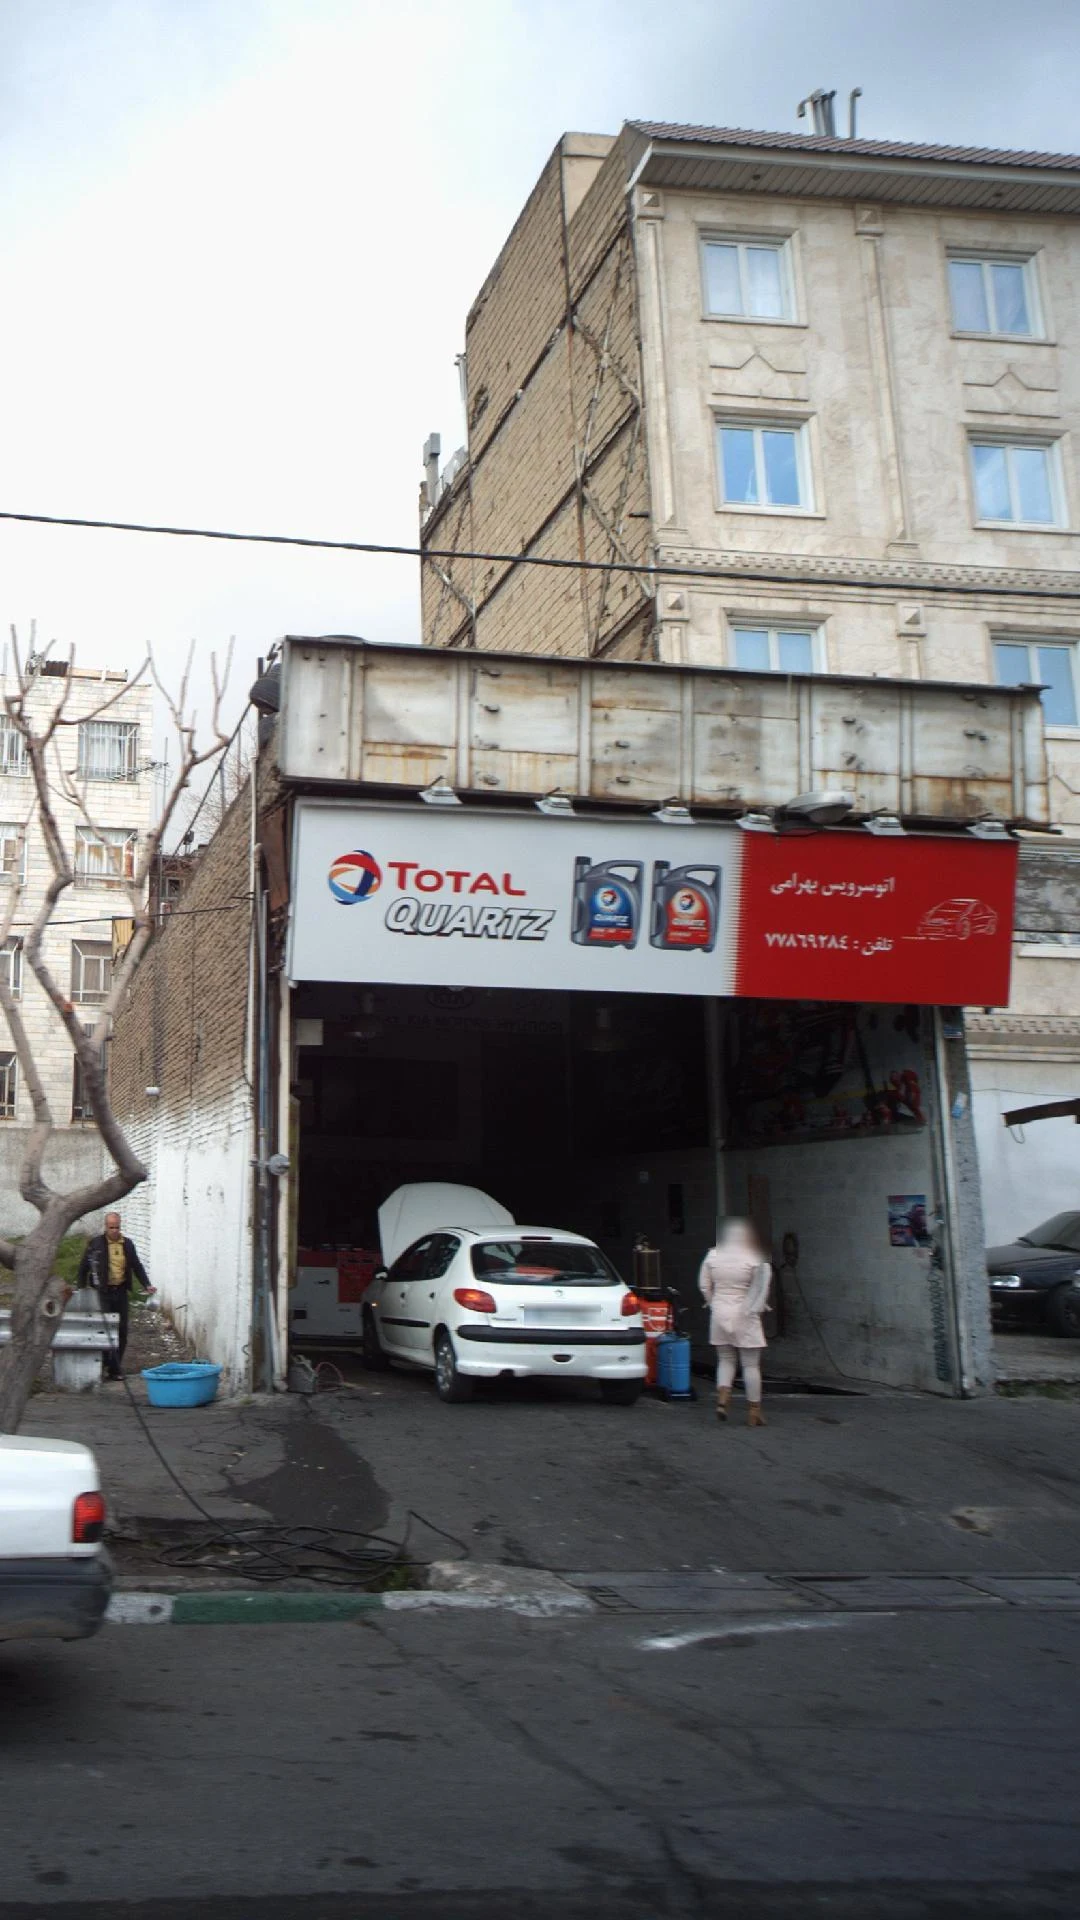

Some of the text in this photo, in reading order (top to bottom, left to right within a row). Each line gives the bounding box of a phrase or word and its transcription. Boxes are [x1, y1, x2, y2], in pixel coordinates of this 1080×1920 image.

[387, 861, 527, 897] TOTAL
[771, 872, 818, 895] بهرامی
[384, 896, 557, 942] QUARTZ
